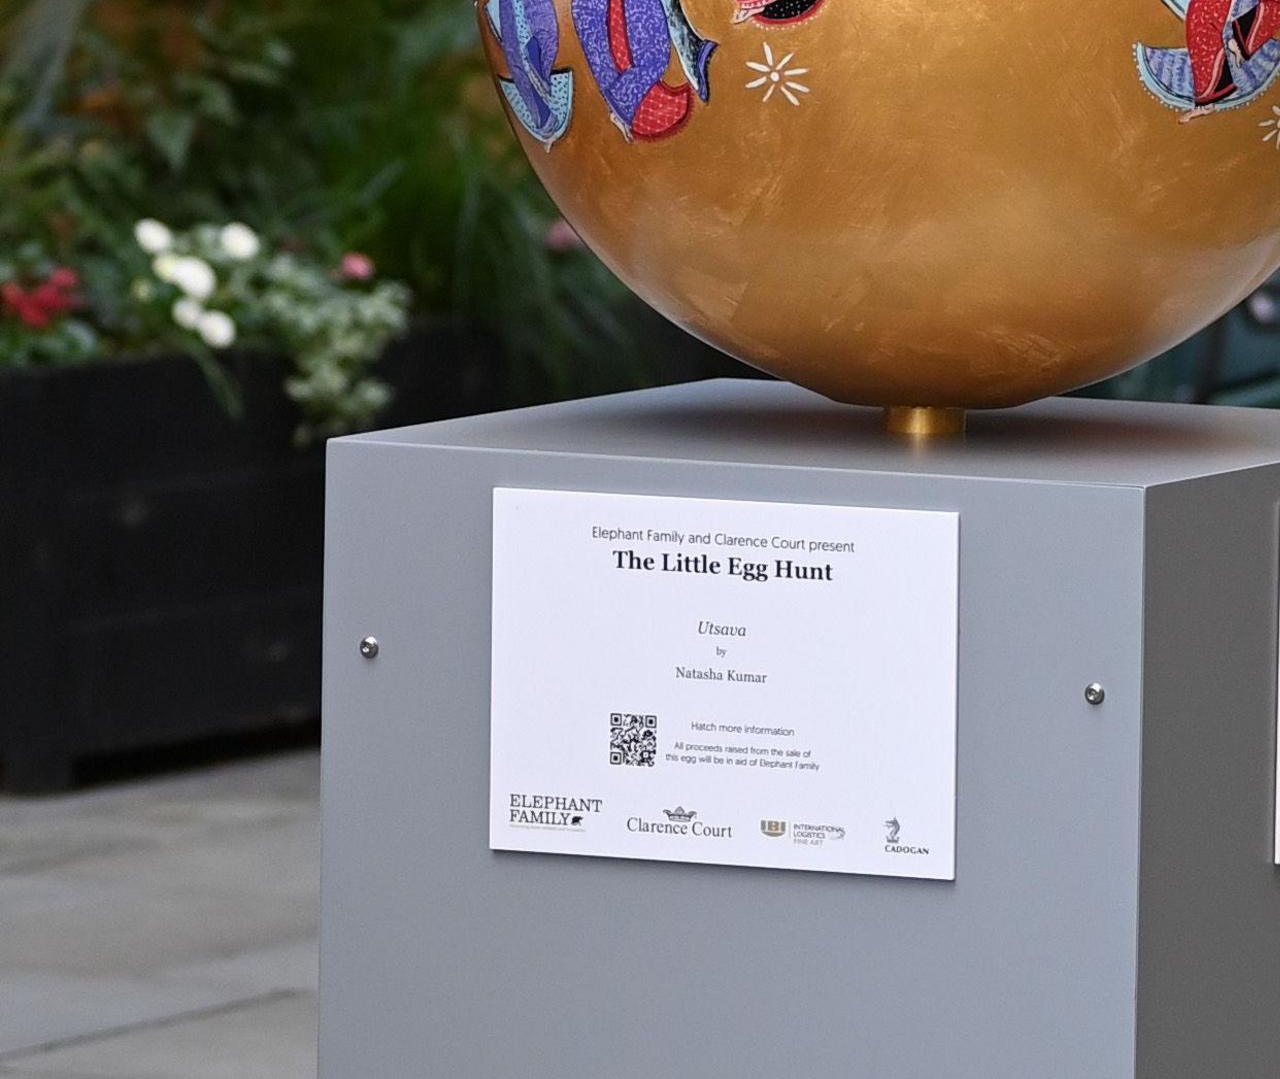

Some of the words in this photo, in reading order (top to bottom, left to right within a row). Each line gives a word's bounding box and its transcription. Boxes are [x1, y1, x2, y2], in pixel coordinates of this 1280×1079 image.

[592, 526, 643, 541] Elephant
[647, 529, 684, 544] Family
[688, 532, 711, 544] and
[715, 533, 768, 548] Clarence
[771, 537, 805, 550] Court
[809, 540, 855, 553] present
[612, 550, 655, 570] The
[662, 552, 720, 574] Little
[728, 556, 768, 581] Egg
[775, 559, 833, 581] Hunt
[698, 621, 746, 636] Utsava
[716, 646, 727, 658] by
[675, 666, 723, 680] Natasha
[728, 670, 767, 683] Kumar
[691, 722, 716, 732] Hatch
[719, 725, 742, 733] more
[744, 725, 795, 736] information
[674, 742, 684, 750] All
[686, 743, 723, 753] proceeds
[725, 745, 748, 754] raised
[750, 747, 769, 755] from
[771, 748, 783, 756] the
[786, 749, 800, 757] sale
[803, 750, 811, 758] of
[666, 753, 678, 761] this
[681, 756, 696, 764] egg
[698, 755, 712, 763] will
[714, 756, 723, 764] be
[749, 759, 757, 767] of
[759, 760, 793, 769] Elephant
[510, 794, 602, 813] ELEPHANT
[510, 809, 570, 825] FAMILY
[627, 817, 688, 835] Clarence
[692, 822, 732, 838] Court
[793, 824, 845, 832] INTERNATIONAL
[793, 831, 825, 839] LOGISTICS
[884, 845, 929, 855] CADOGAN
